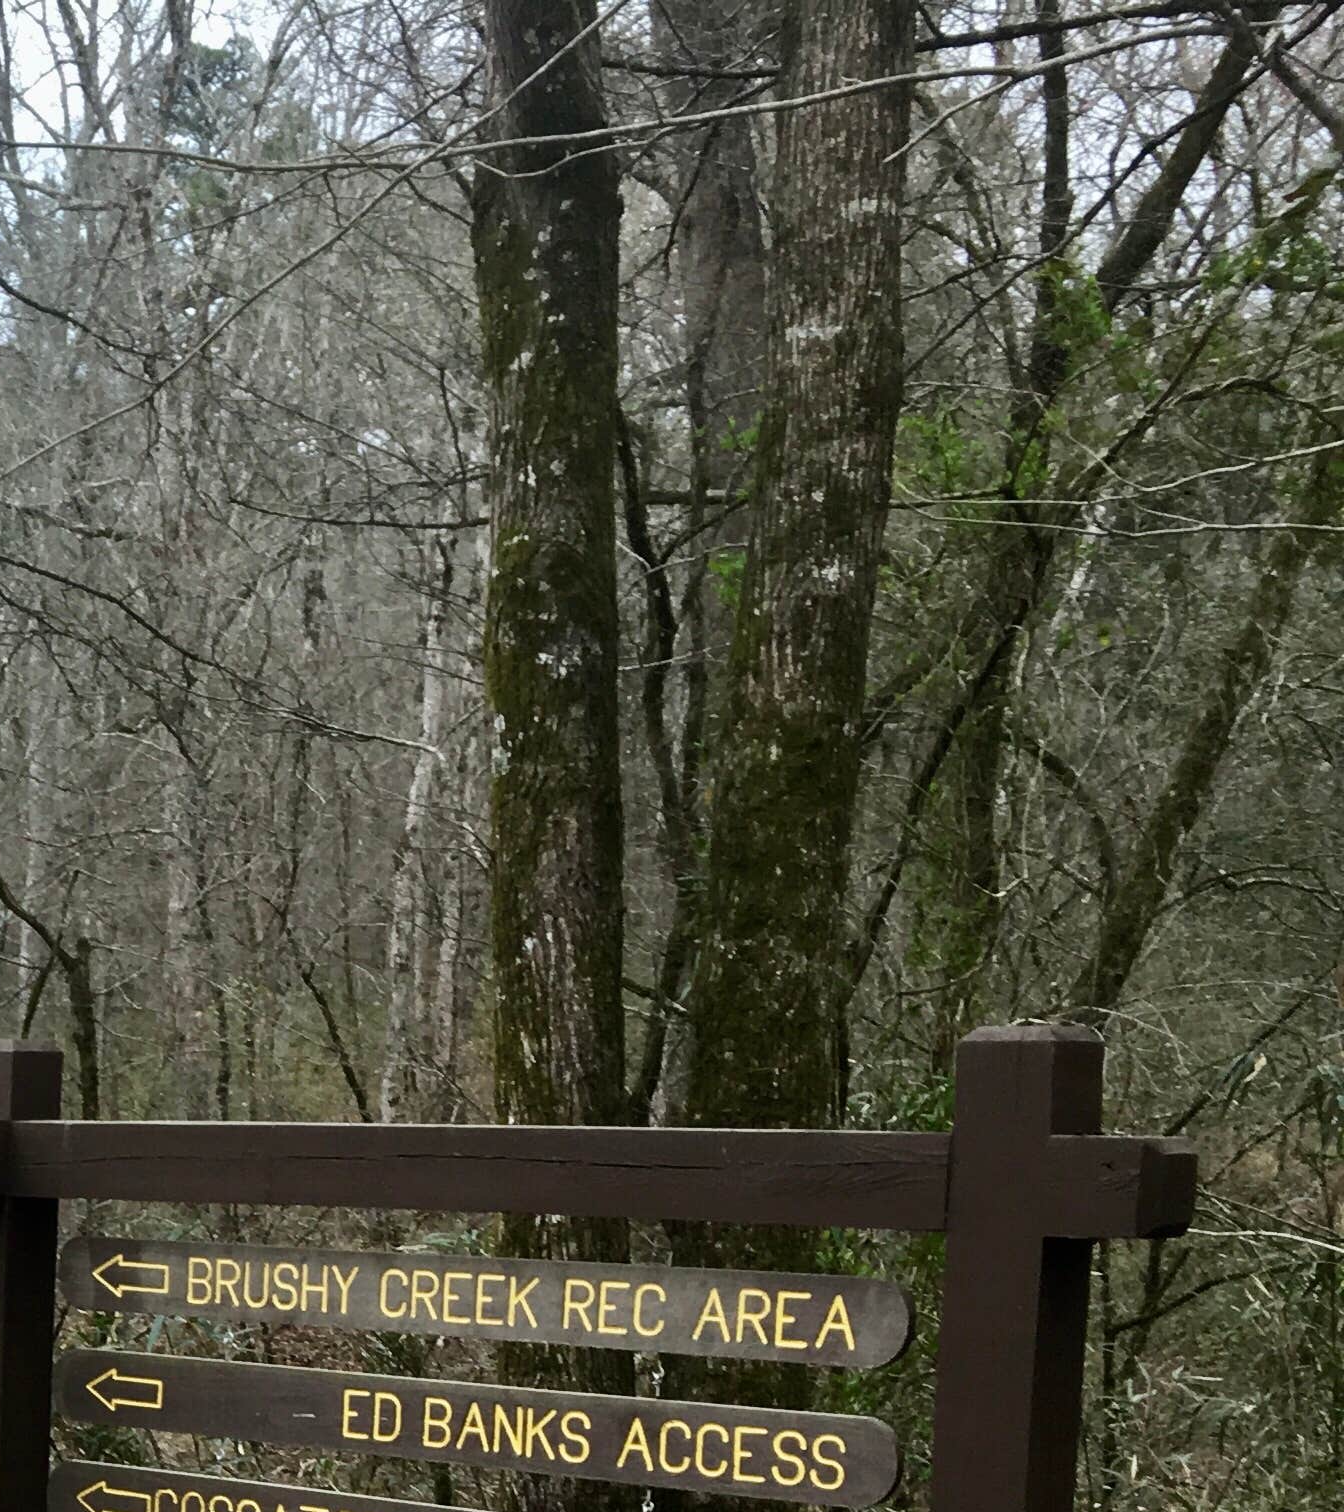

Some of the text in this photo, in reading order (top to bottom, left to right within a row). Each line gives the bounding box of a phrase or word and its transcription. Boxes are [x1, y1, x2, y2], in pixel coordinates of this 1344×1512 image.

[184, 1254, 857, 1352] BRUSHY CREEK REC AREA
[340, 1387, 846, 1491] ED BANKS ACCESS
